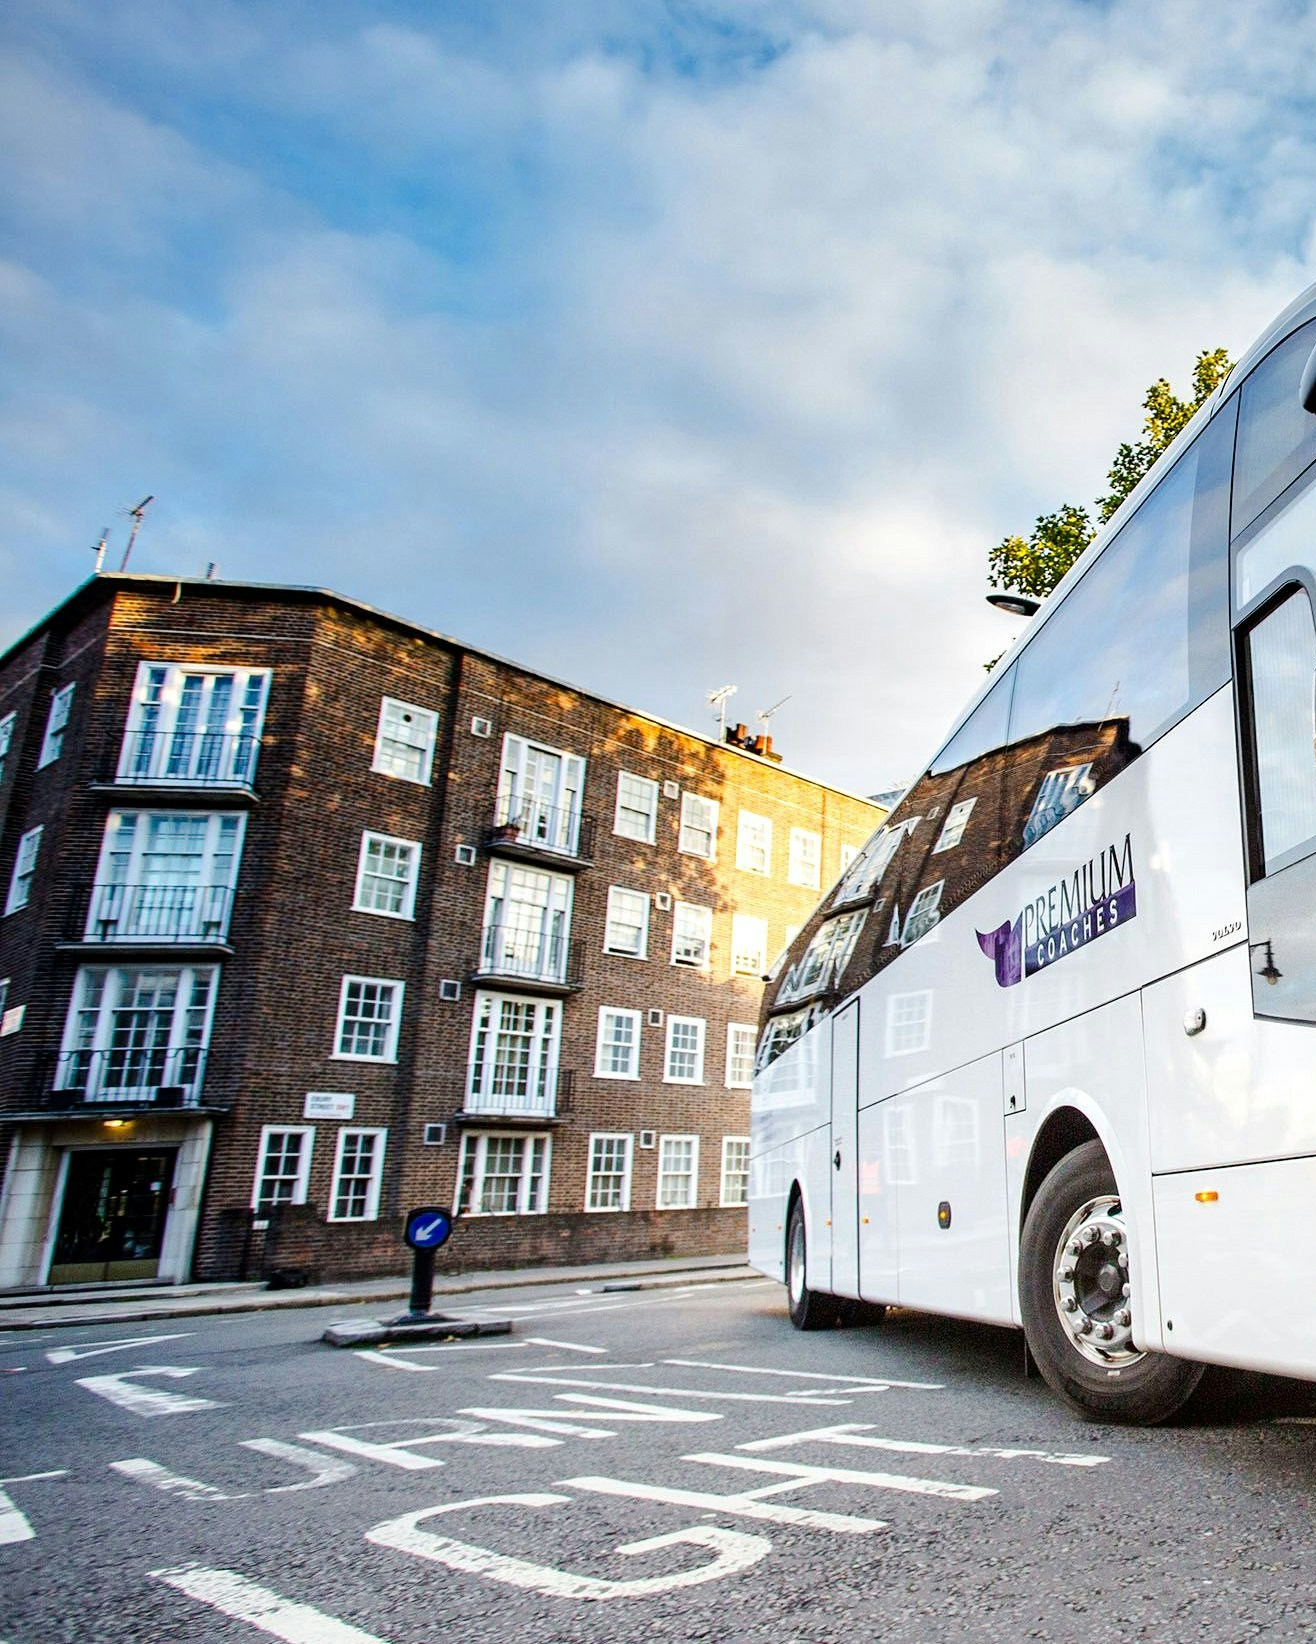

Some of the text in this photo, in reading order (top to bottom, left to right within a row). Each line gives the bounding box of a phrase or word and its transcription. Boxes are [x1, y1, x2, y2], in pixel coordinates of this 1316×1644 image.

[1024, 832, 1135, 948] PREMIUM
[1037, 898, 1118, 966] COACHES
[147, 1423, 1113, 1644] IGHT
